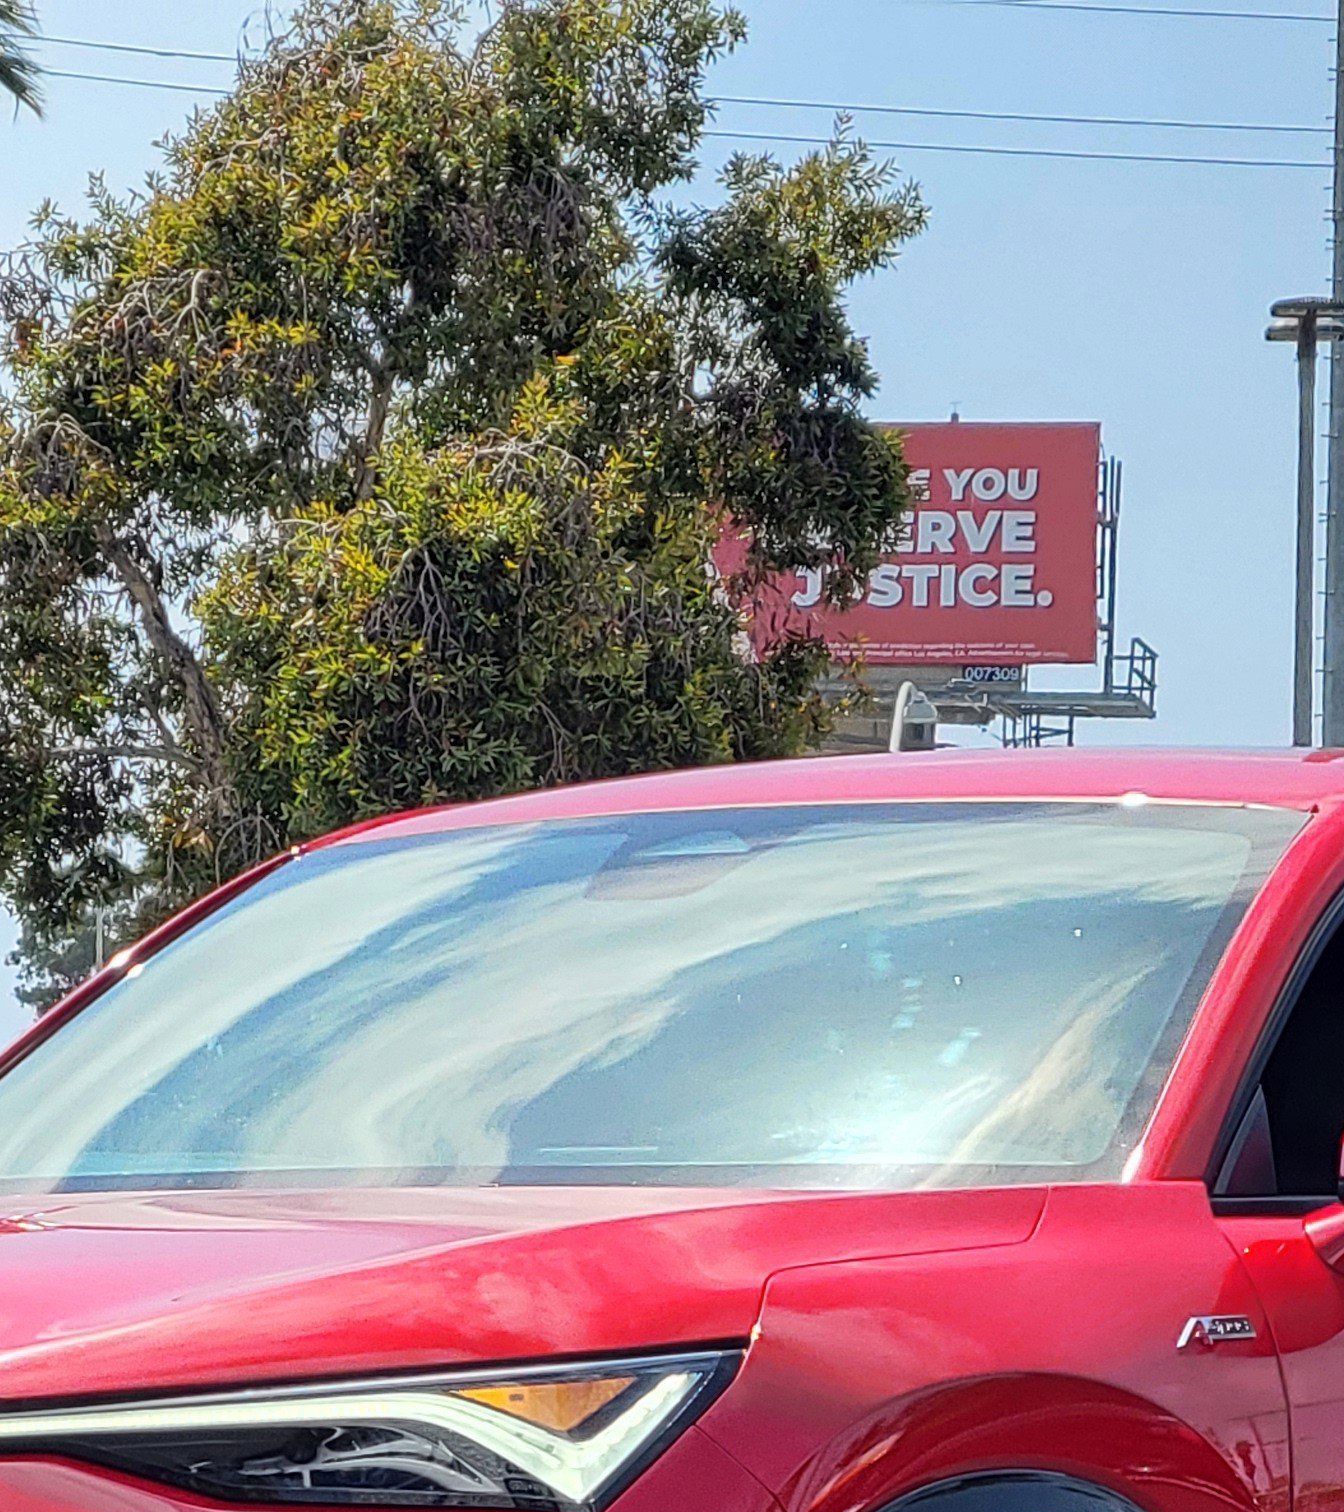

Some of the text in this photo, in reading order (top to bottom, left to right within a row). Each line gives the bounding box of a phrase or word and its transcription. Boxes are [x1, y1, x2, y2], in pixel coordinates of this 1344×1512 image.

[942, 467, 1039, 501] YOU
[790, 563, 1054, 608] JSTICE.
[964, 666, 1020, 682] 007309
